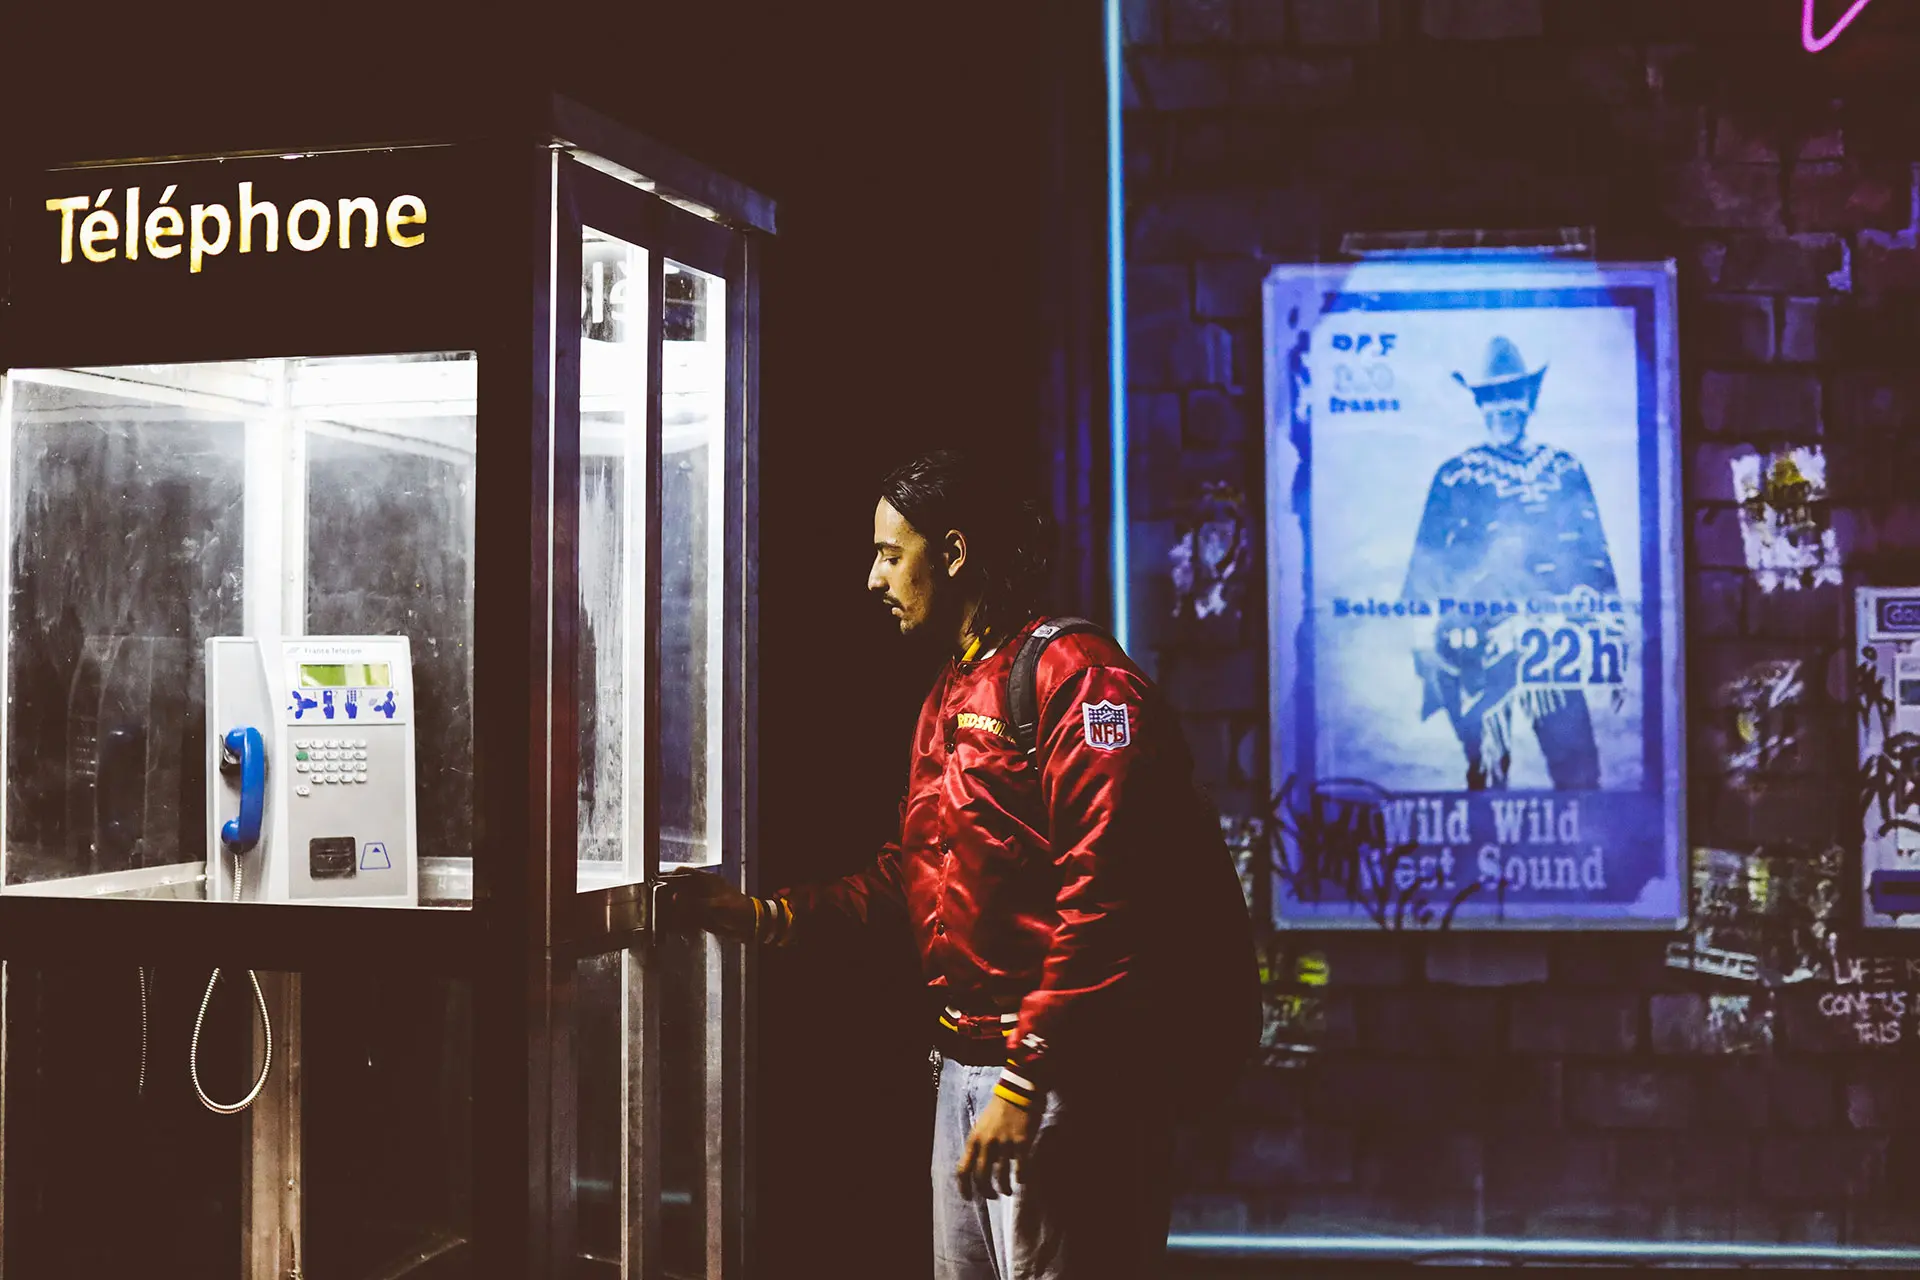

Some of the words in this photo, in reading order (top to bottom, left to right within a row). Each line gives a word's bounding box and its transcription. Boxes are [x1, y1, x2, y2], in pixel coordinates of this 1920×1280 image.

[46, 181, 428, 273] Téléphone
[1381, 798, 1471, 845] Wild
[1490, 798, 1581, 845] Wild
[1477, 843, 1607, 892] Sound
